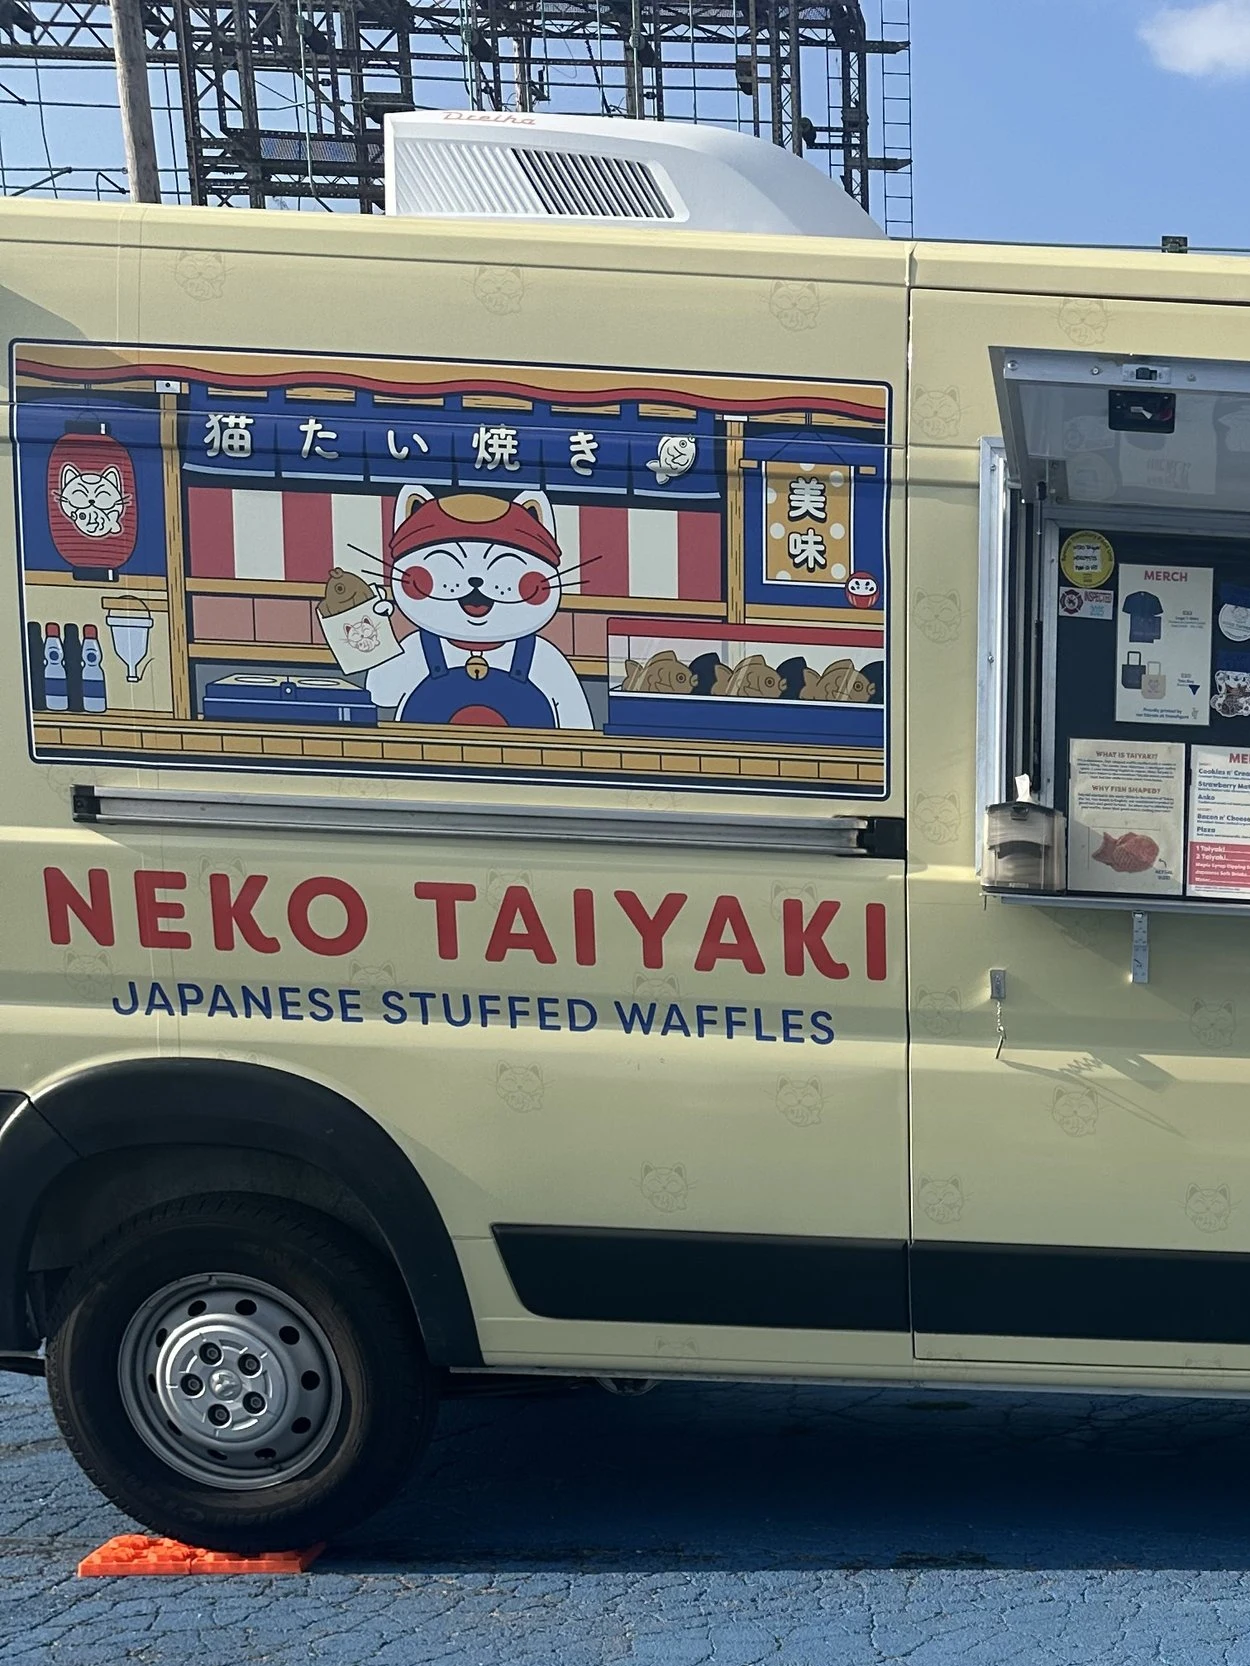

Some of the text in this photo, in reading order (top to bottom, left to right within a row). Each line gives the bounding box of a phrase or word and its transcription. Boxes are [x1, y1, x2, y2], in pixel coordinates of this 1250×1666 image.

[204, 412, 599, 477] 猫たい焼き
[787, 475, 828, 573] 美味
[1144, 569, 1188, 582] MERCH
[1198, 768, 1226, 776] Cookies
[1198, 781, 1236, 791] Strawberry
[43, 866, 887, 981] NEKO TAIYAKI
[112, 981, 836, 1045] JAPANESE STUFFED WAFFLES
